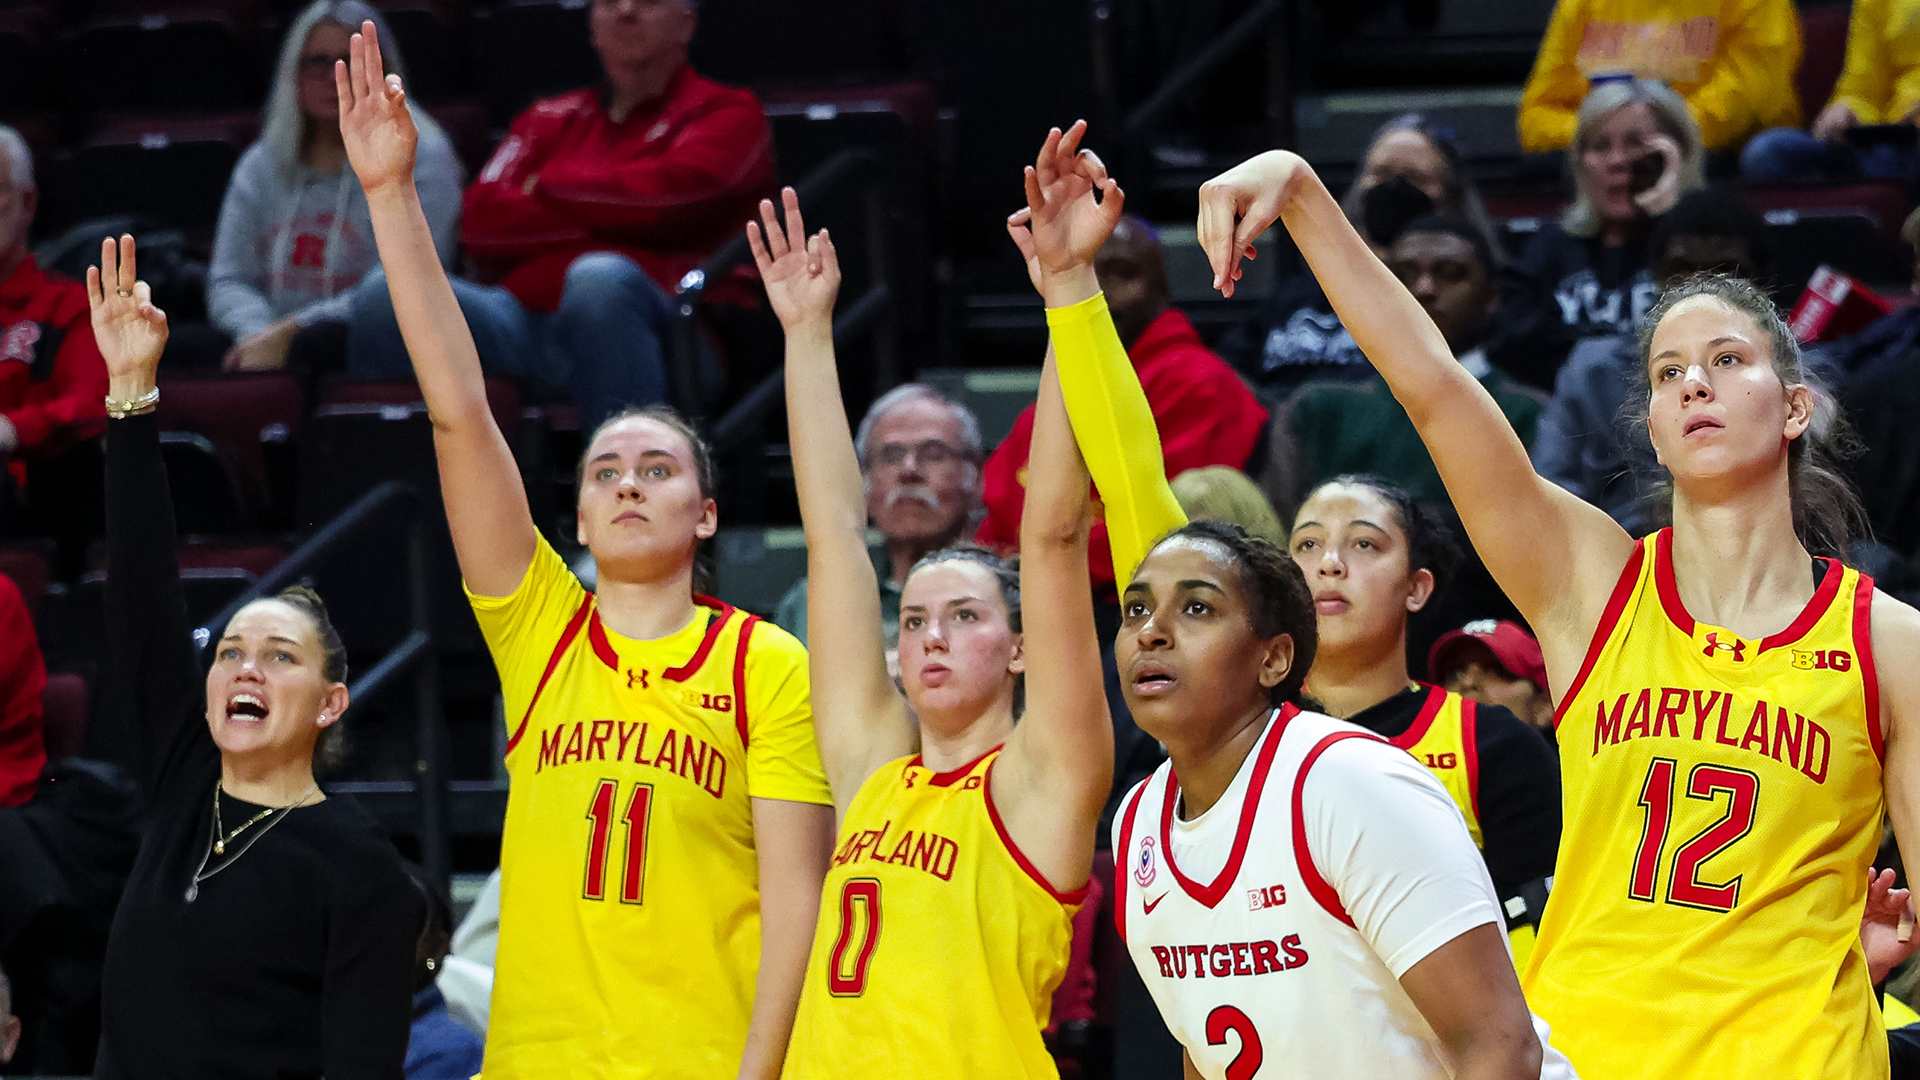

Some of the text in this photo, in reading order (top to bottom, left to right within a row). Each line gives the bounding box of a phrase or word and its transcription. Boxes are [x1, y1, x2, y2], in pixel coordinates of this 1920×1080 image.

[535, 720, 727, 799] MARYLAND
[1592, 687, 1831, 785] MARYLAND
[582, 777, 654, 905] 11
[1628, 757, 1760, 913] 12
[828, 877, 883, 998] 0
[1150, 933, 1309, 979] RUTGERS
[1205, 1004, 1263, 1080] 2
